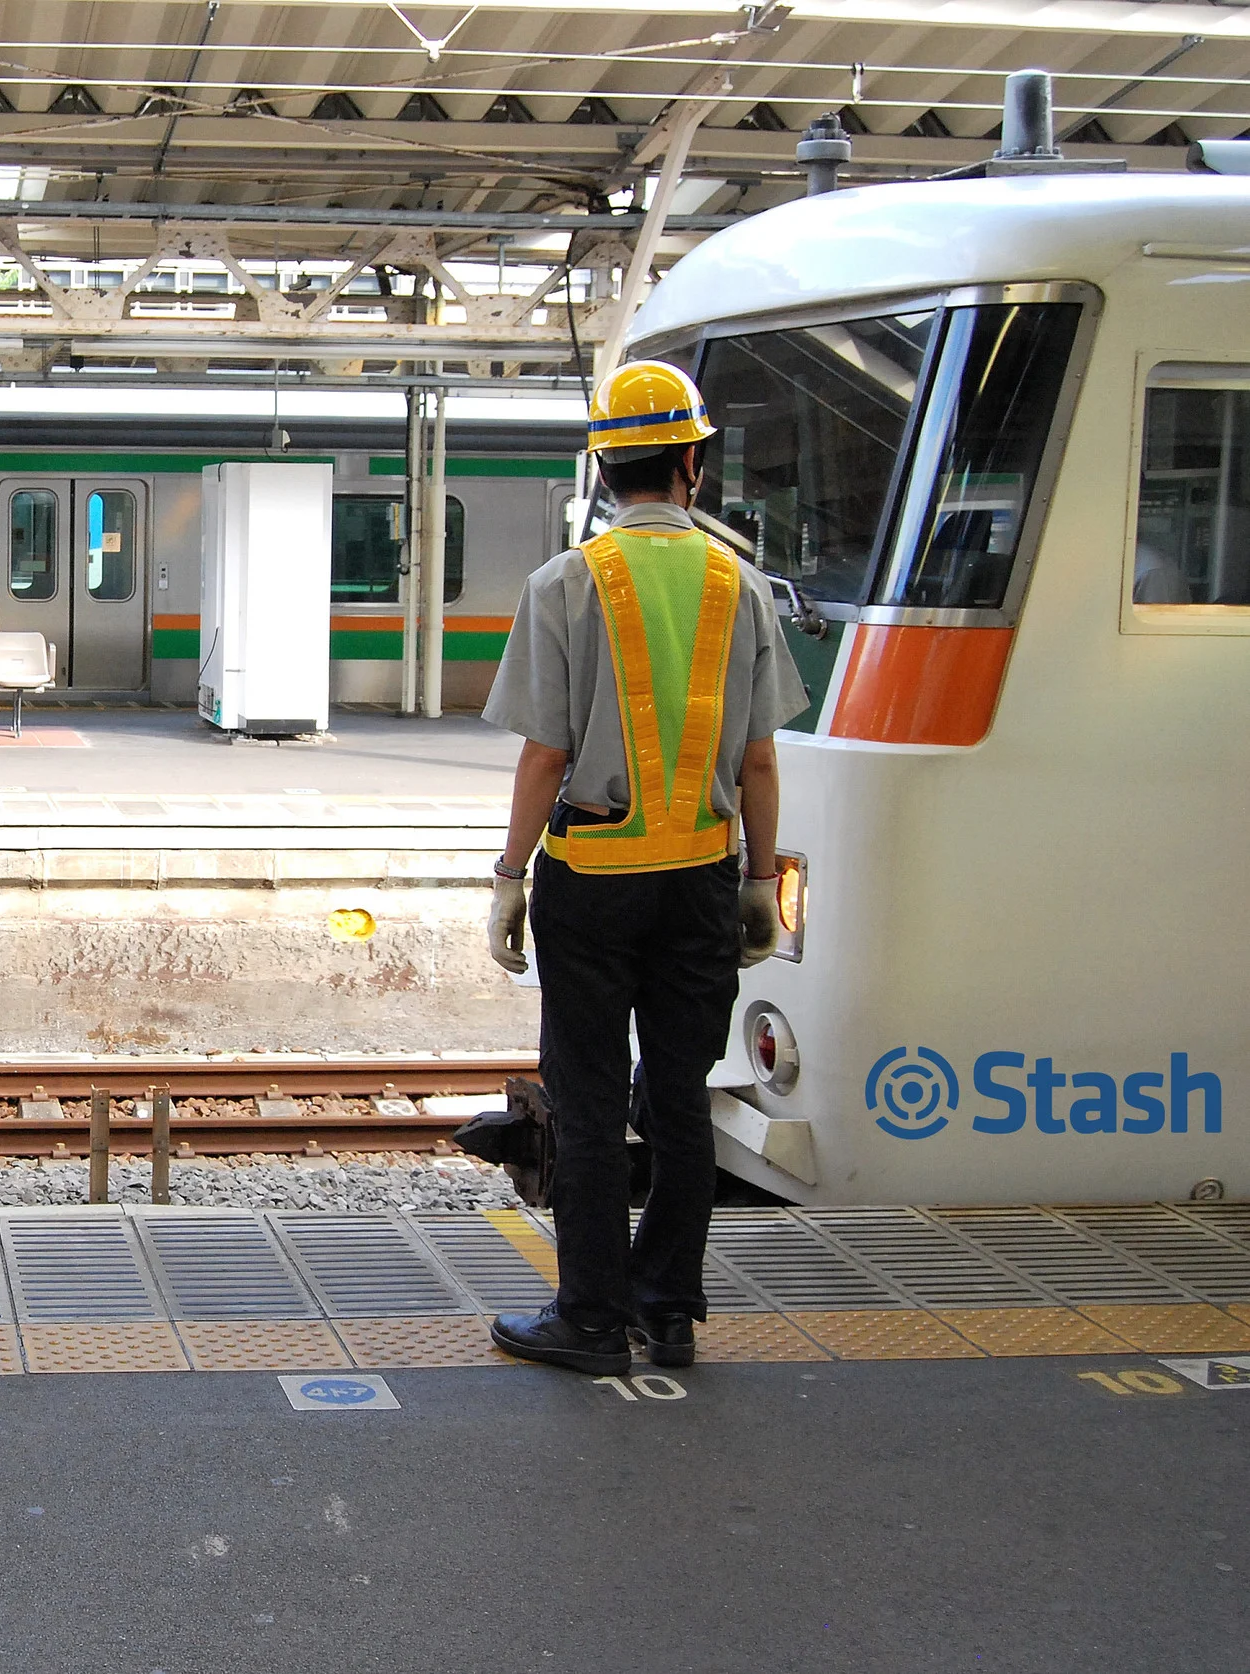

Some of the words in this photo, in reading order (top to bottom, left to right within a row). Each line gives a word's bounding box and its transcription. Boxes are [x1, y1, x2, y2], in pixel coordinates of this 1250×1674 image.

[972, 1051, 1222, 1134] Stash
[593, 1374, 688, 1401] 10
[1077, 1370, 1184, 1394] 10
